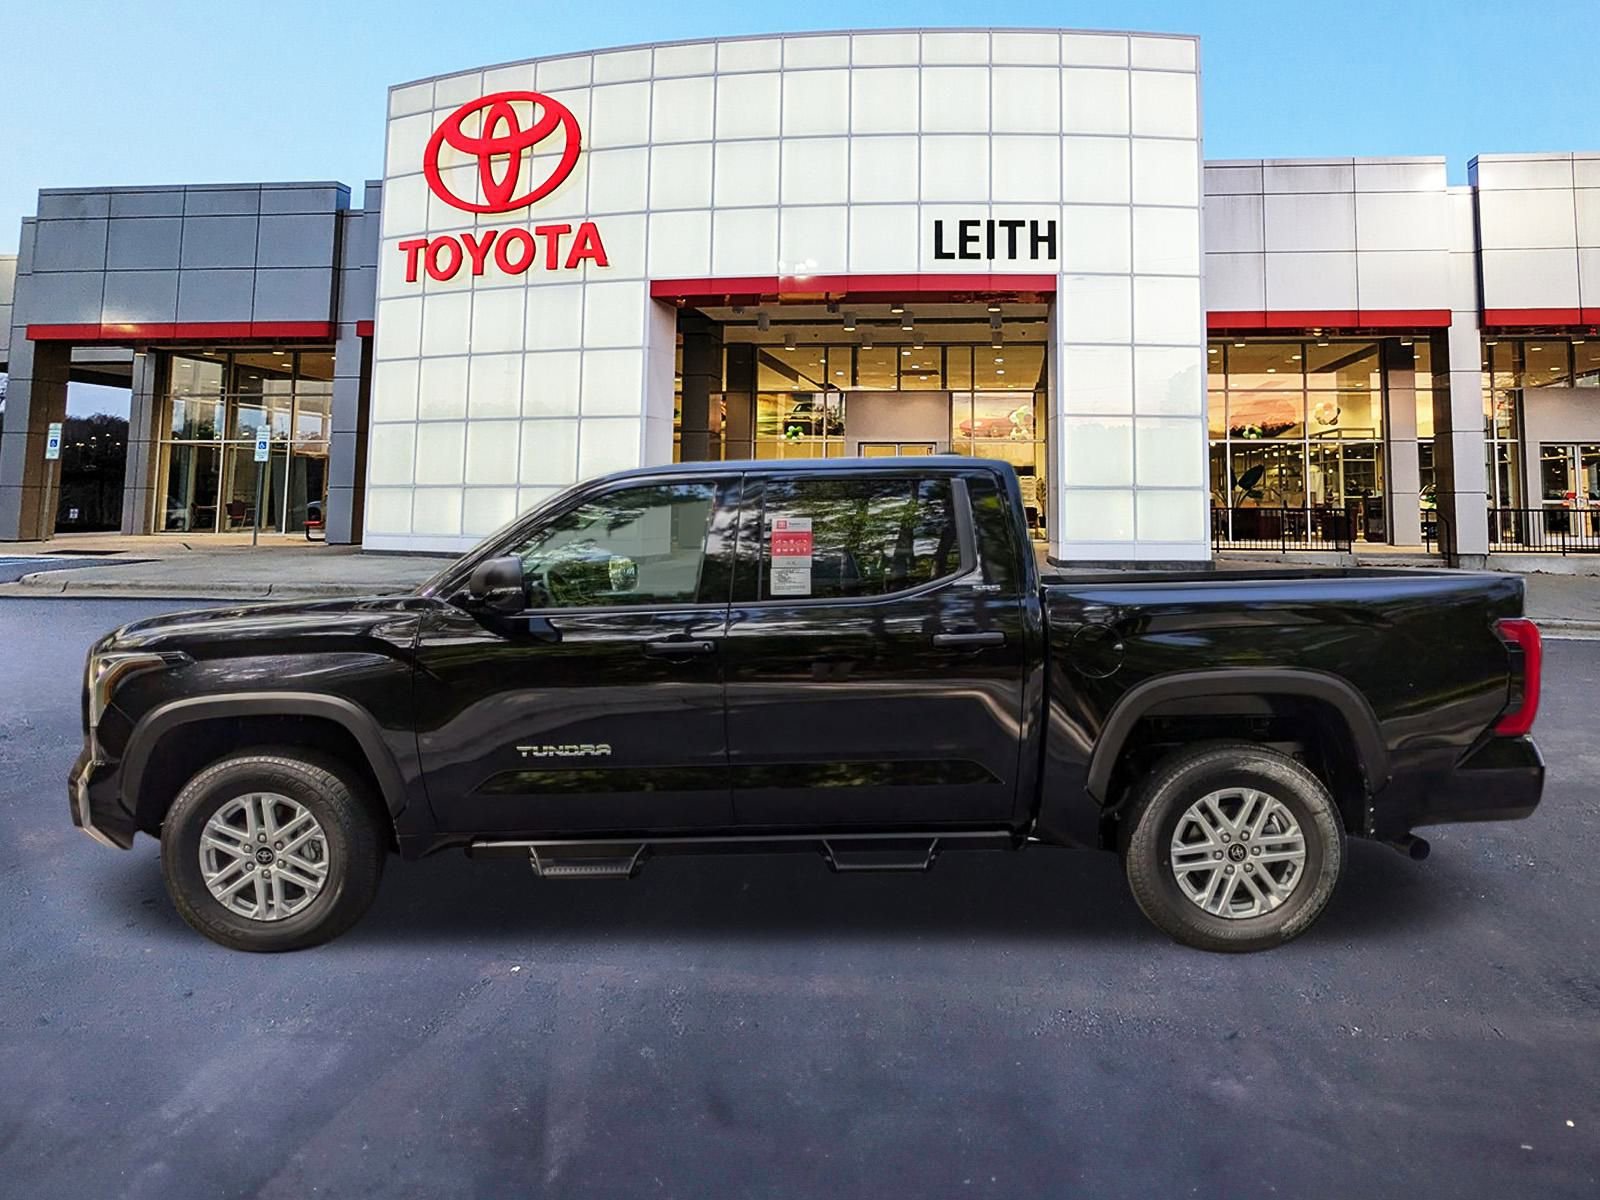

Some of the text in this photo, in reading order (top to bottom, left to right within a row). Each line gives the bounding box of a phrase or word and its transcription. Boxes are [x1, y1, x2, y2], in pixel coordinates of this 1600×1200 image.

[398, 222, 609, 282] TOYOTA
[934, 219, 1057, 260] LEITH
[516, 743, 612, 757] TUNDRA
